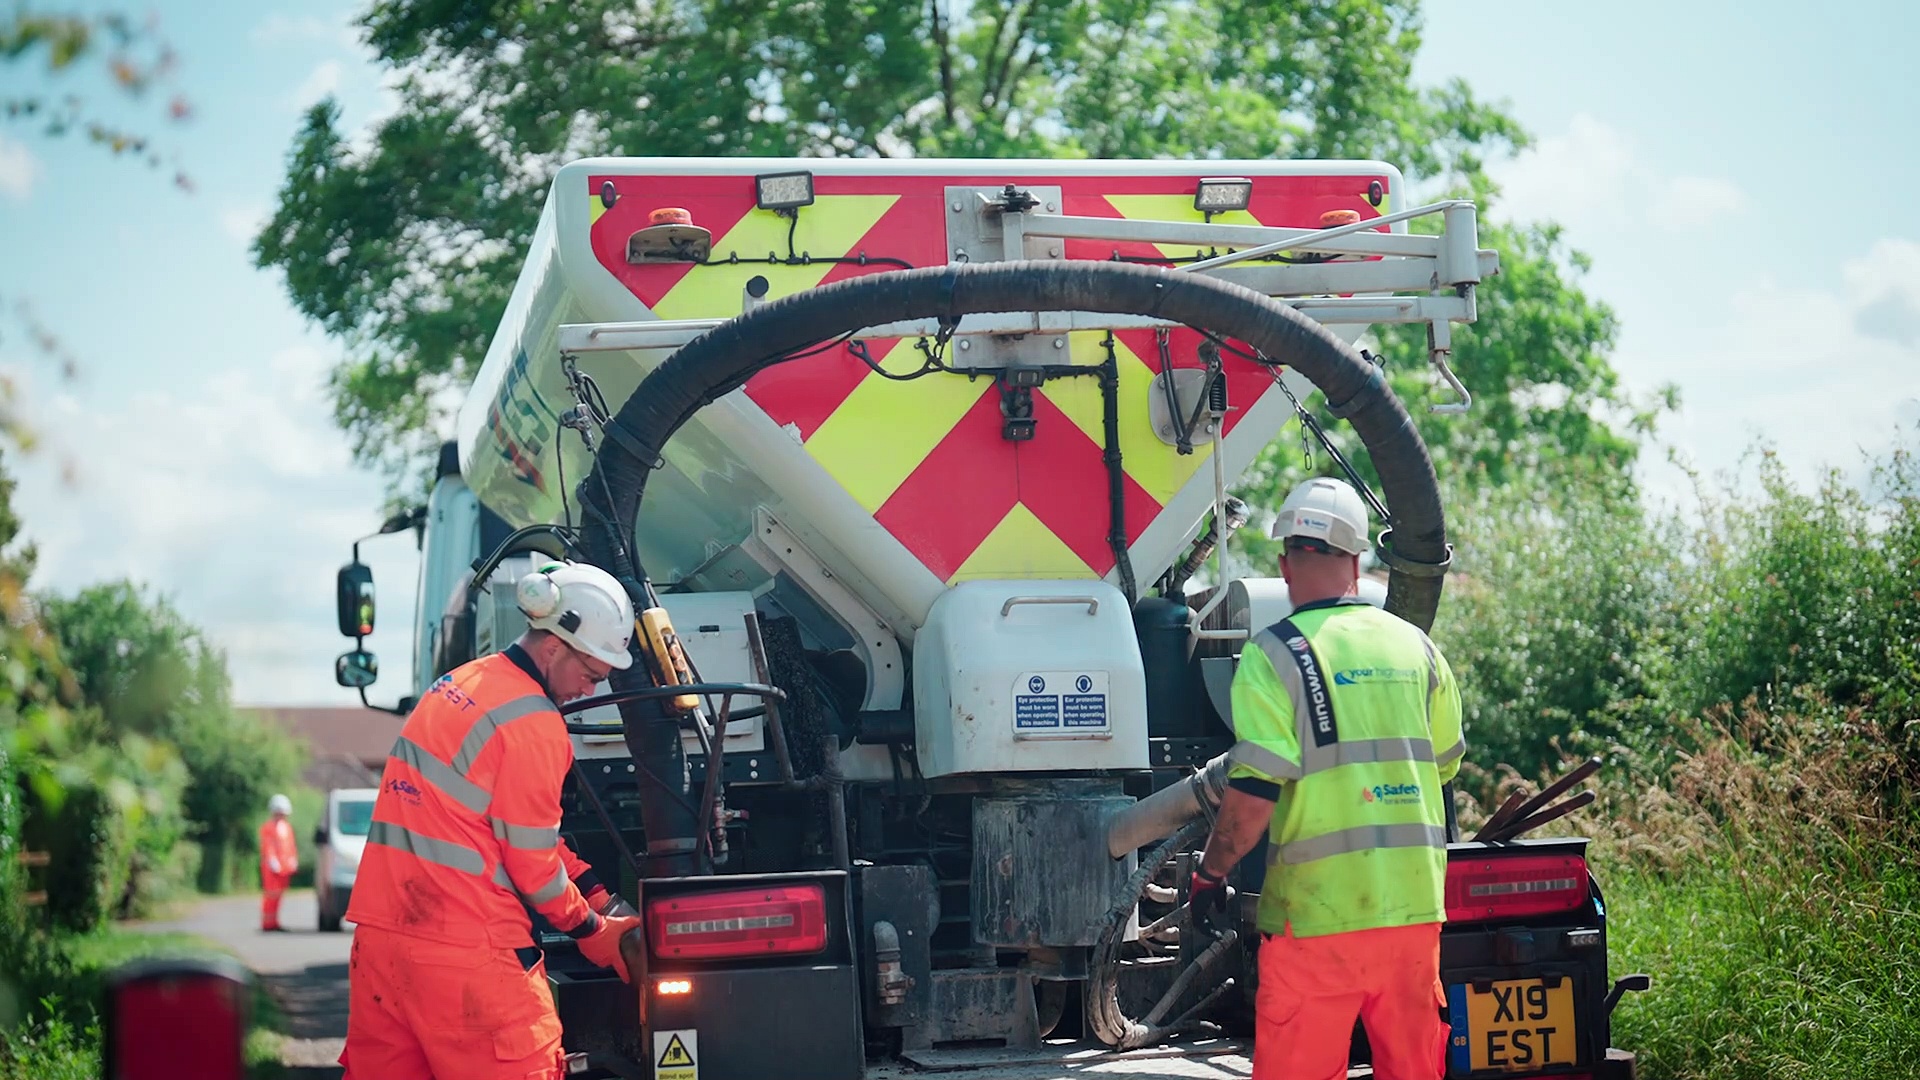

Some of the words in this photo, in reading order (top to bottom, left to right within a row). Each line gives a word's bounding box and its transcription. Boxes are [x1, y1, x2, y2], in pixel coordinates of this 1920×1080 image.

[1348, 668, 1373, 679] your
[1300, 654, 1332, 733] RINGWAY
[1018, 696, 1028, 704] Eye
[1029, 696, 1057, 704] protection
[1075, 696, 1104, 704] protection
[1383, 783, 1420, 797] Safety
[1491, 985, 1548, 1023] X19
[1453, 1036, 1467, 1046] GB
[1487, 1027, 1556, 1066] EST
